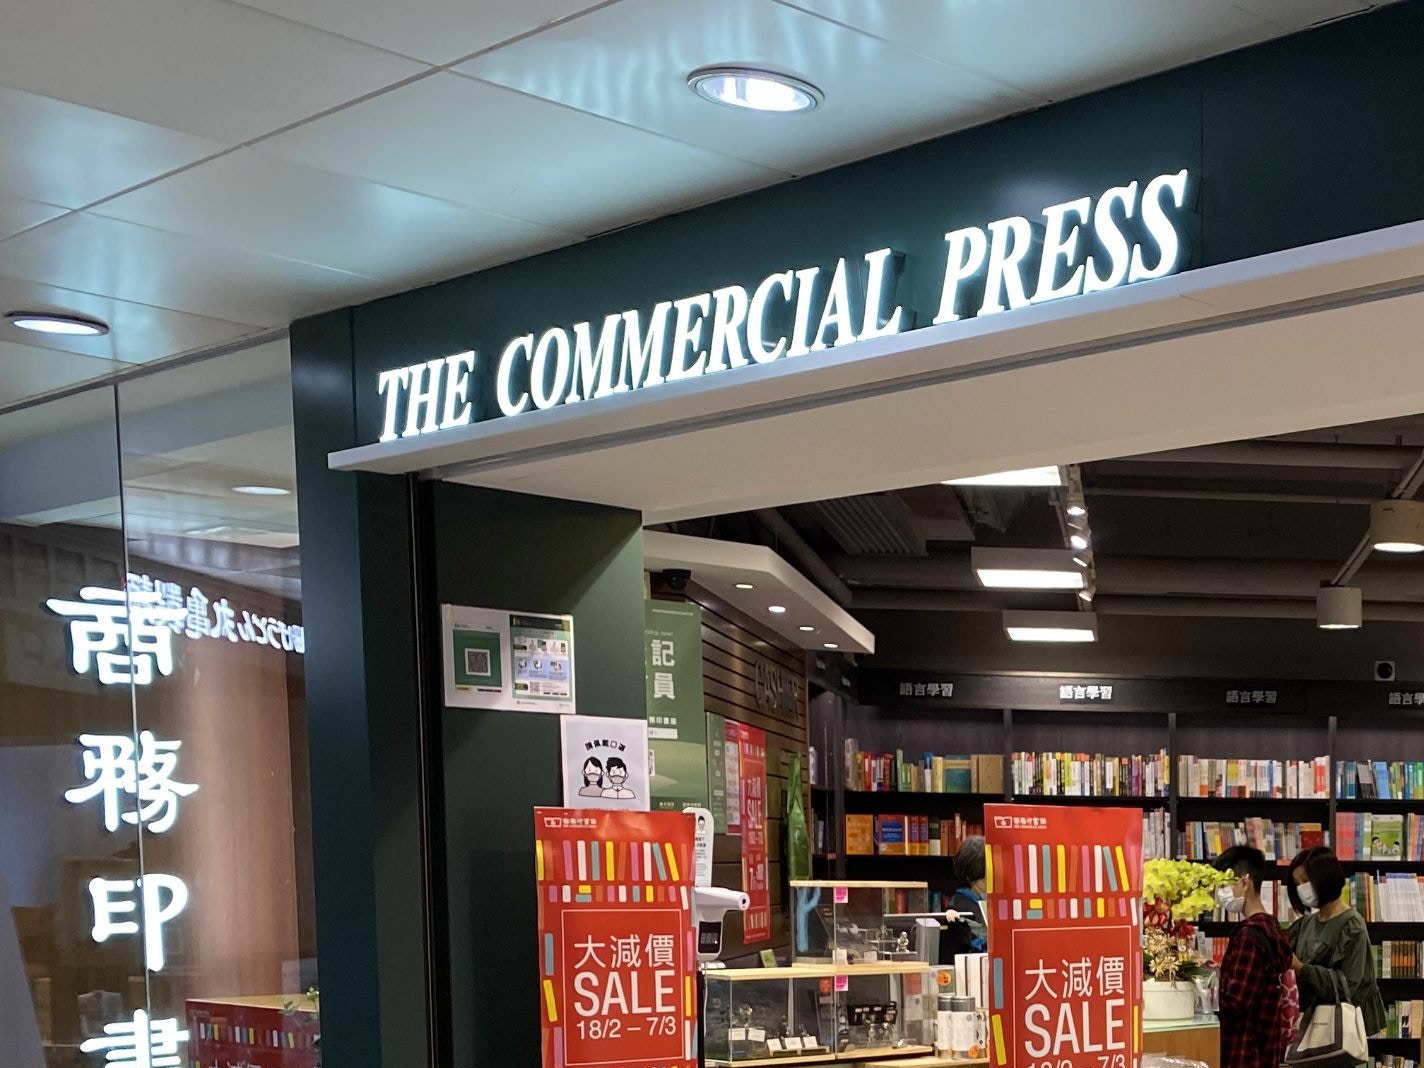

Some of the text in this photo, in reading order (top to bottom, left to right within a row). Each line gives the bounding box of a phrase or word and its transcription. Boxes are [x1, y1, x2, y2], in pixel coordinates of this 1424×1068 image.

[378, 168, 1190, 443] THE COMMERCIAL PRESS
[899, 682, 954, 698] 語言學習
[1059, 684, 1113, 700] 語言學習
[1226, 689, 1278, 704] 語言學習
[574, 934, 675, 968] 大減價
[574, 970, 676, 1017] SALE
[1024, 956, 1125, 1000] 大減價
[576, 1018, 622, 1040] 18/2
[646, 1016, 676, 1036] 7/3
[1025, 999, 1126, 1058] SALE
